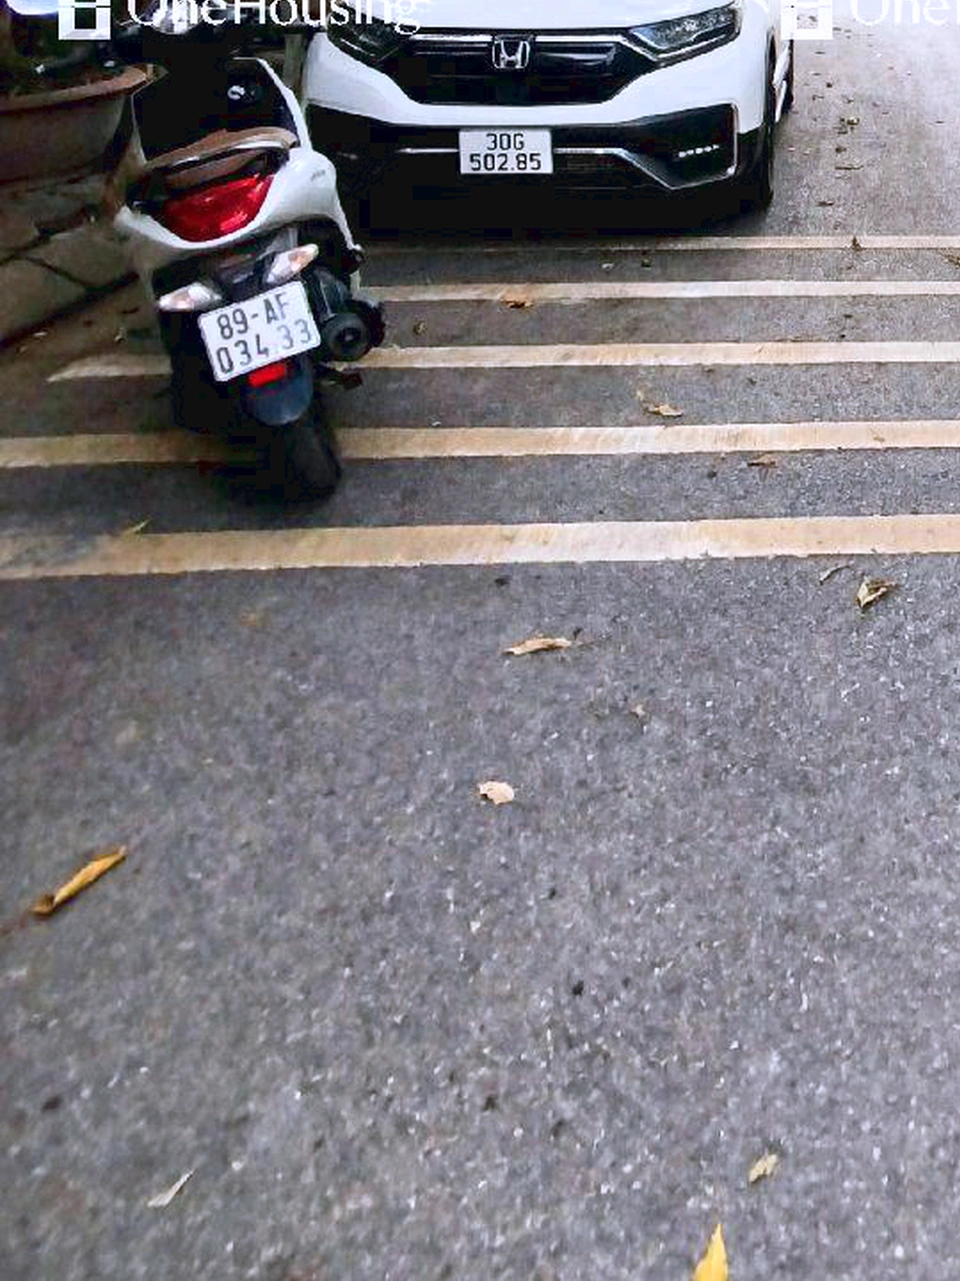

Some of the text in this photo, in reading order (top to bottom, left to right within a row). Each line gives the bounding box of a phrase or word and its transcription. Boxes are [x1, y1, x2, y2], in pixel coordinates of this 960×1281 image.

[486, 132, 525, 151] 30G
[469, 152, 542, 172] 502.85
[216, 292, 290, 341] 89-AF
